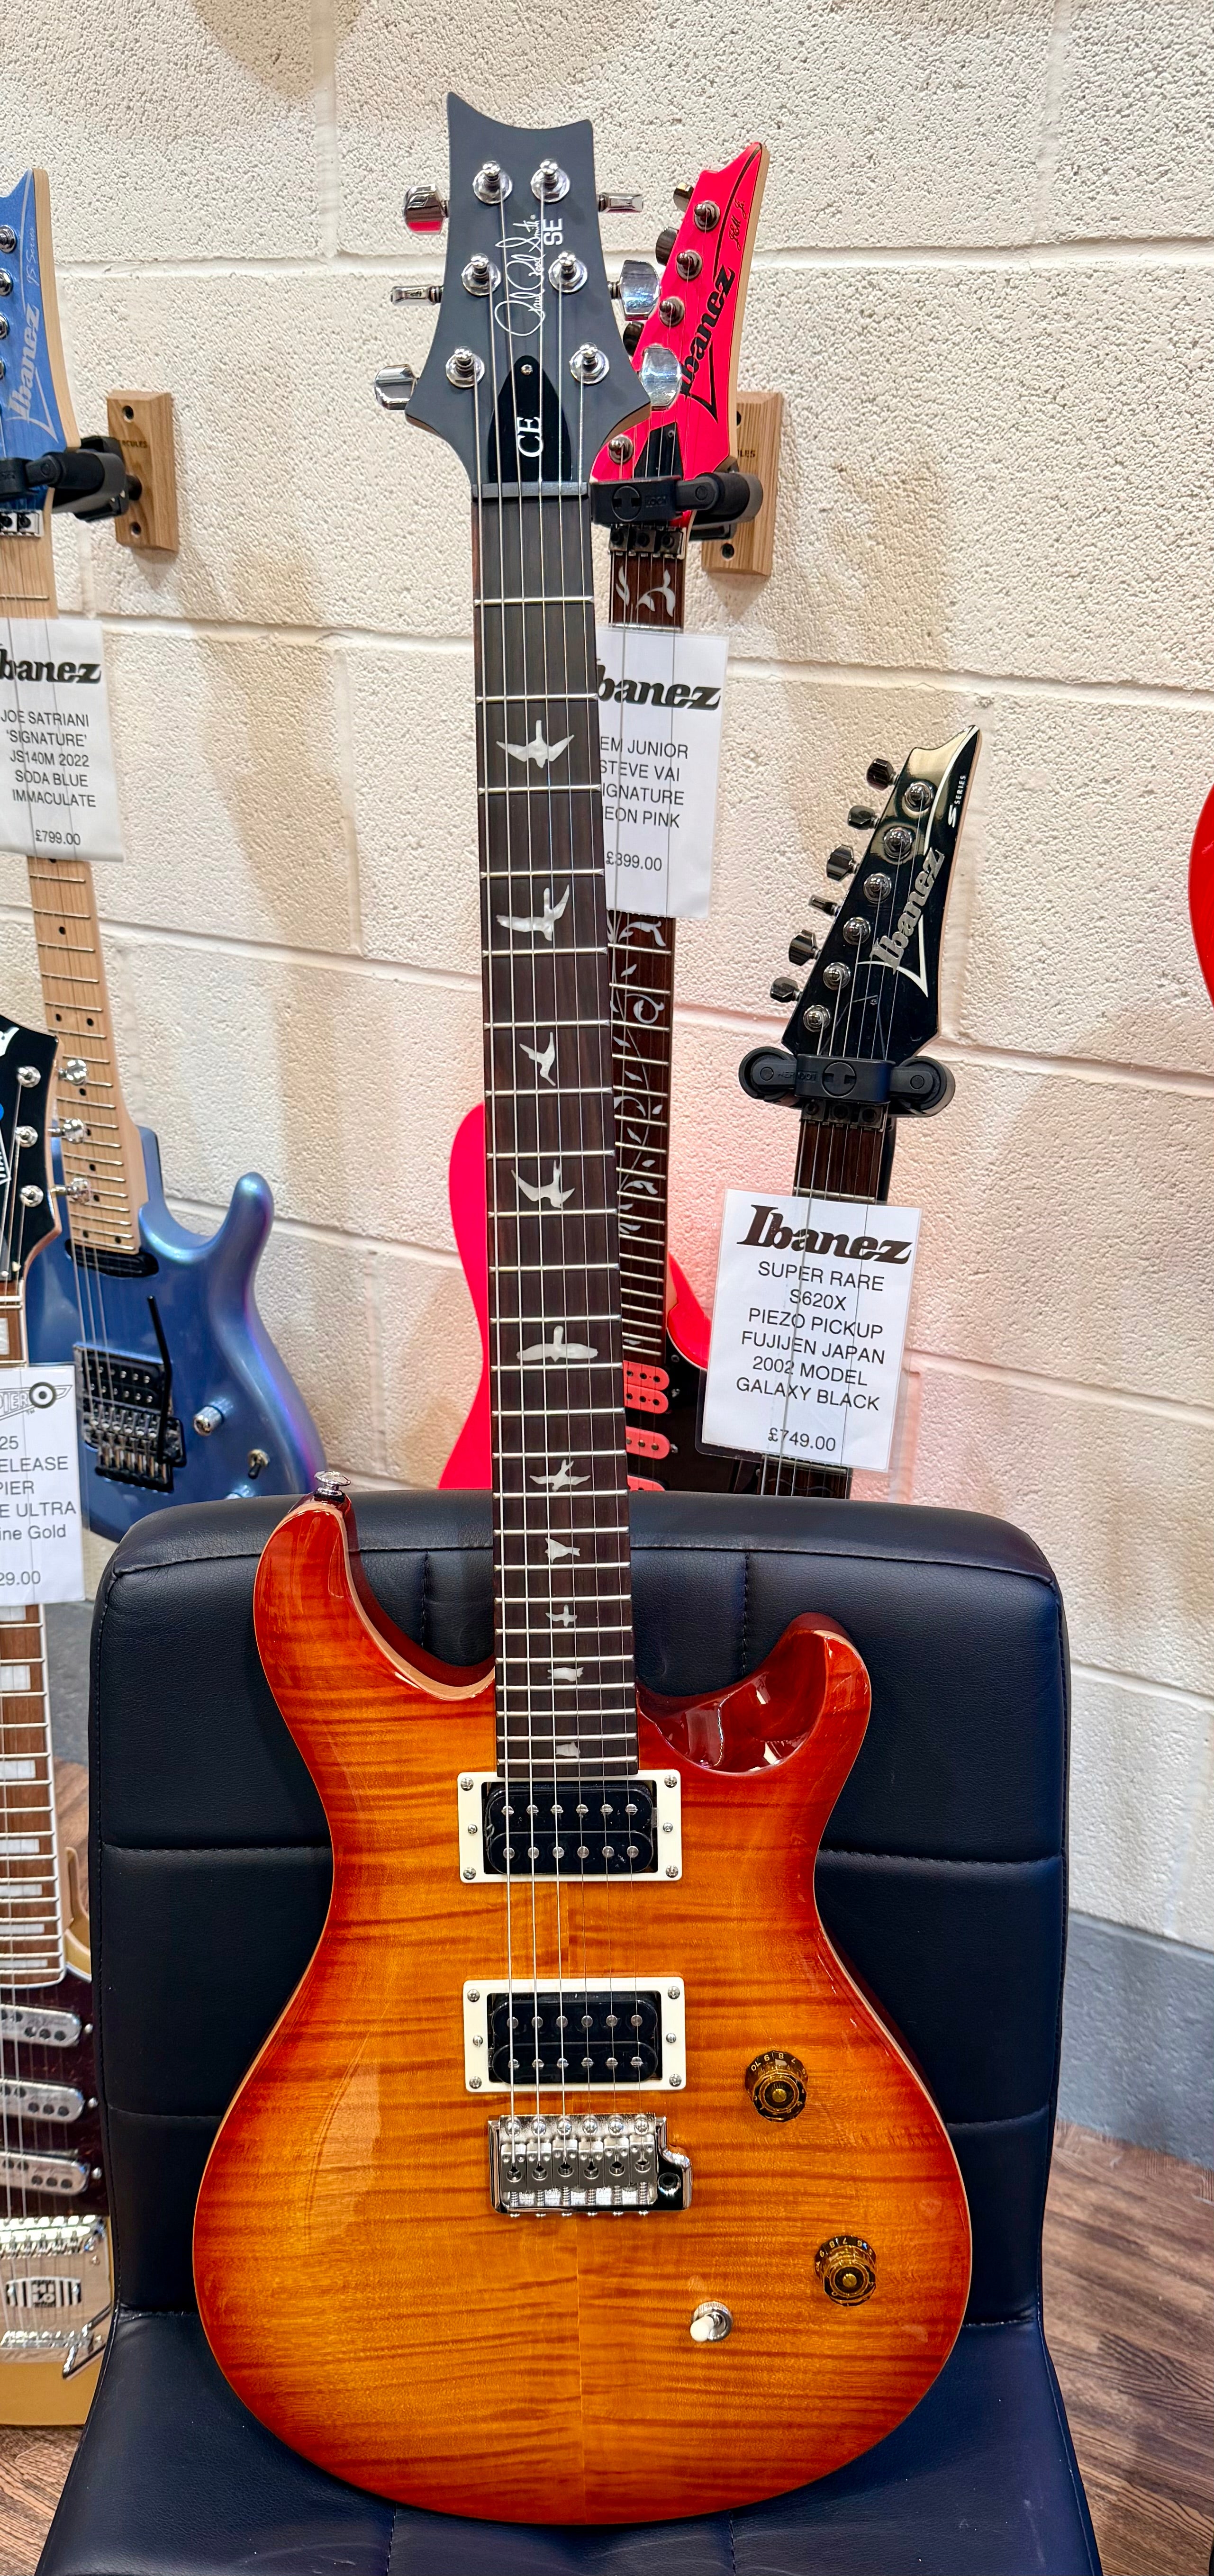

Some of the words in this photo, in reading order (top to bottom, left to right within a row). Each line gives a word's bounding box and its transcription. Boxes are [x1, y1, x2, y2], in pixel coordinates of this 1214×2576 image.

[543, 218, 563, 245] SE
[8, 303, 40, 424] Ibanez
[516, 417, 544, 457] CE
[0, 648, 101, 684] banez
[597, 664, 722, 711] banez
[0, 709, 25, 723] JOE
[27, 711, 89, 727] SATRIANI
[9, 750, 55, 766] JS140M
[59, 753, 90, 768] 2022
[600, 736, 623, 752] EM
[627, 740, 689, 759] JUNIOR
[15, 769, 50, 785] SODA
[53, 773, 89, 787] BLUE
[600, 759, 649, 779] STEVE
[654, 766, 680, 782] VAI
[12, 789, 97, 807] IMMACULATE
[603, 783, 684, 805] IGNATURE
[954, 775, 967, 805] SERIES
[605, 806, 637, 823] EON
[643, 811, 680, 829] PINK
[35, 830, 81, 846] £799.00
[869, 847, 945, 975] Ibanez
[736, 1204, 913, 1265] Ibanez
[758, 1261, 824, 1283] SUPER
[830, 1271, 885, 1292] RARE
[789, 1289, 847, 1311] S620X
[748, 1307, 806, 1329] PIEZO
[810, 1316, 883, 1339] PICKUP
[741, 1330, 816, 1355] FUJIJEN
[822, 1343, 885, 1365] JAPAN
[752, 1356, 795, 1375] 2002
[799, 1362, 868, 1386] MODEL
[736, 1376, 812, 1401] GALAXY
[816, 1389, 880, 1411] BLACK
[0, 1436, 18, 1450] 25
[767, 1427, 836, 1452] £749.00
[0, 1455, 69, 1473] ELEASE
[0, 1504, 10, 1518] E
[16, 1500, 76, 1518] ULTRA
[0, 1527, 22, 1540] ine
[27, 1524, 66, 1539] Gold
[0, 1570, 41, 1586] 29.00
